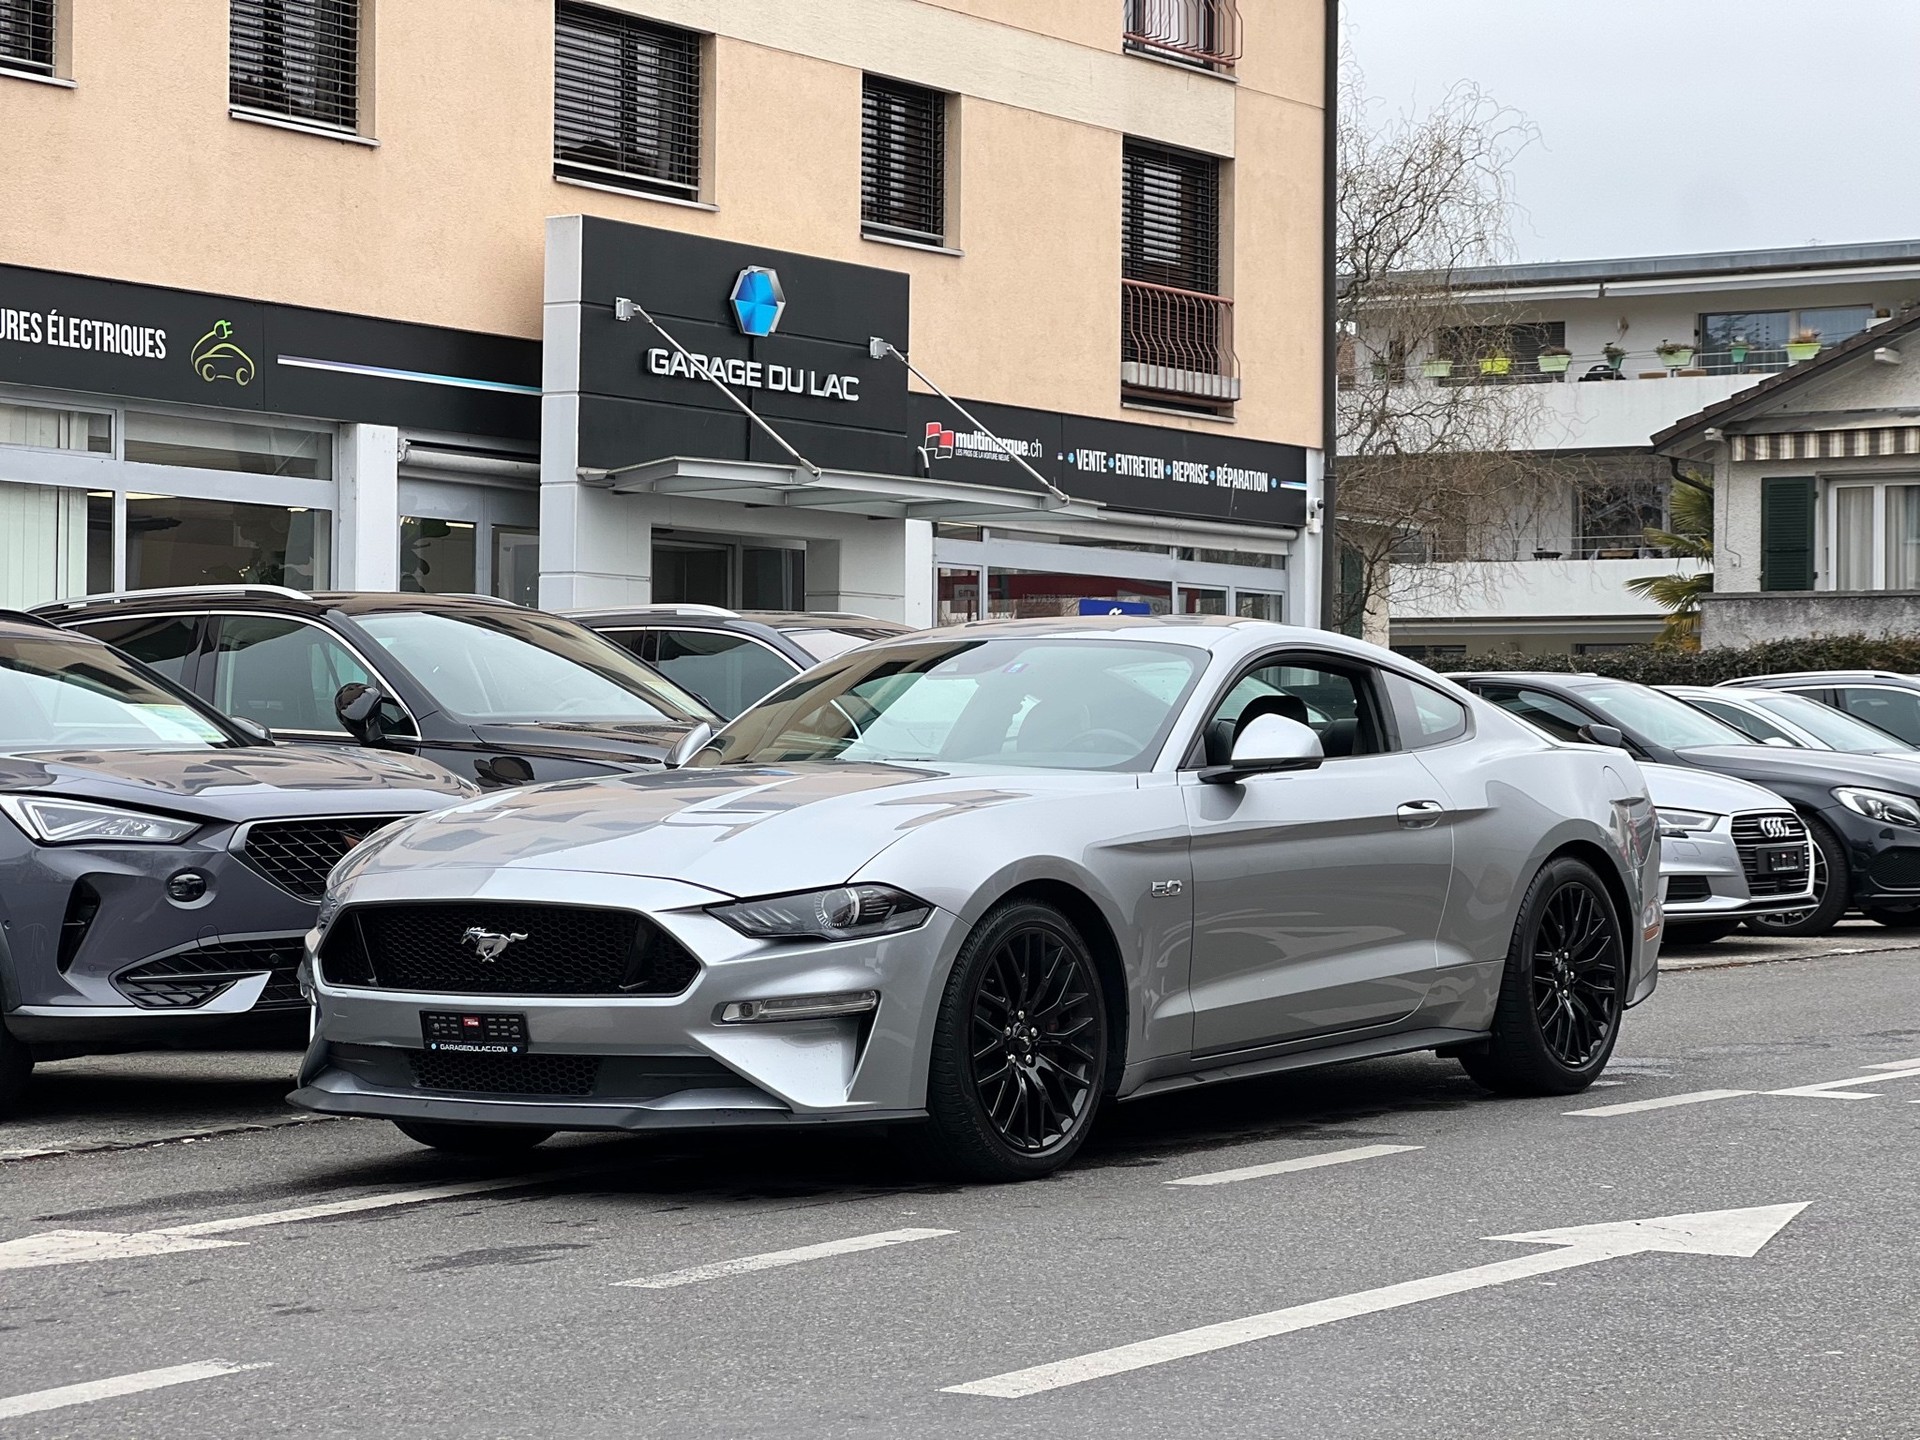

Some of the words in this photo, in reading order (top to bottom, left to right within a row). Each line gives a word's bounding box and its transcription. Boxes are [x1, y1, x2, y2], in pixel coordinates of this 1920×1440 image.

[47, 309, 167, 359] ÉLECTRIQUES
[648, 348, 762, 388] GARAGE
[767, 363, 804, 393] DU
[809, 371, 860, 401] LAC
[1076, 448, 1107, 473] VENTE
[1115, 453, 1164, 480] ENTRETIEN
[1172, 460, 1209, 485] REPRISE
[1216, 463, 1268, 493] RÉPARATION
[1151, 880, 1183, 898] 5.0
